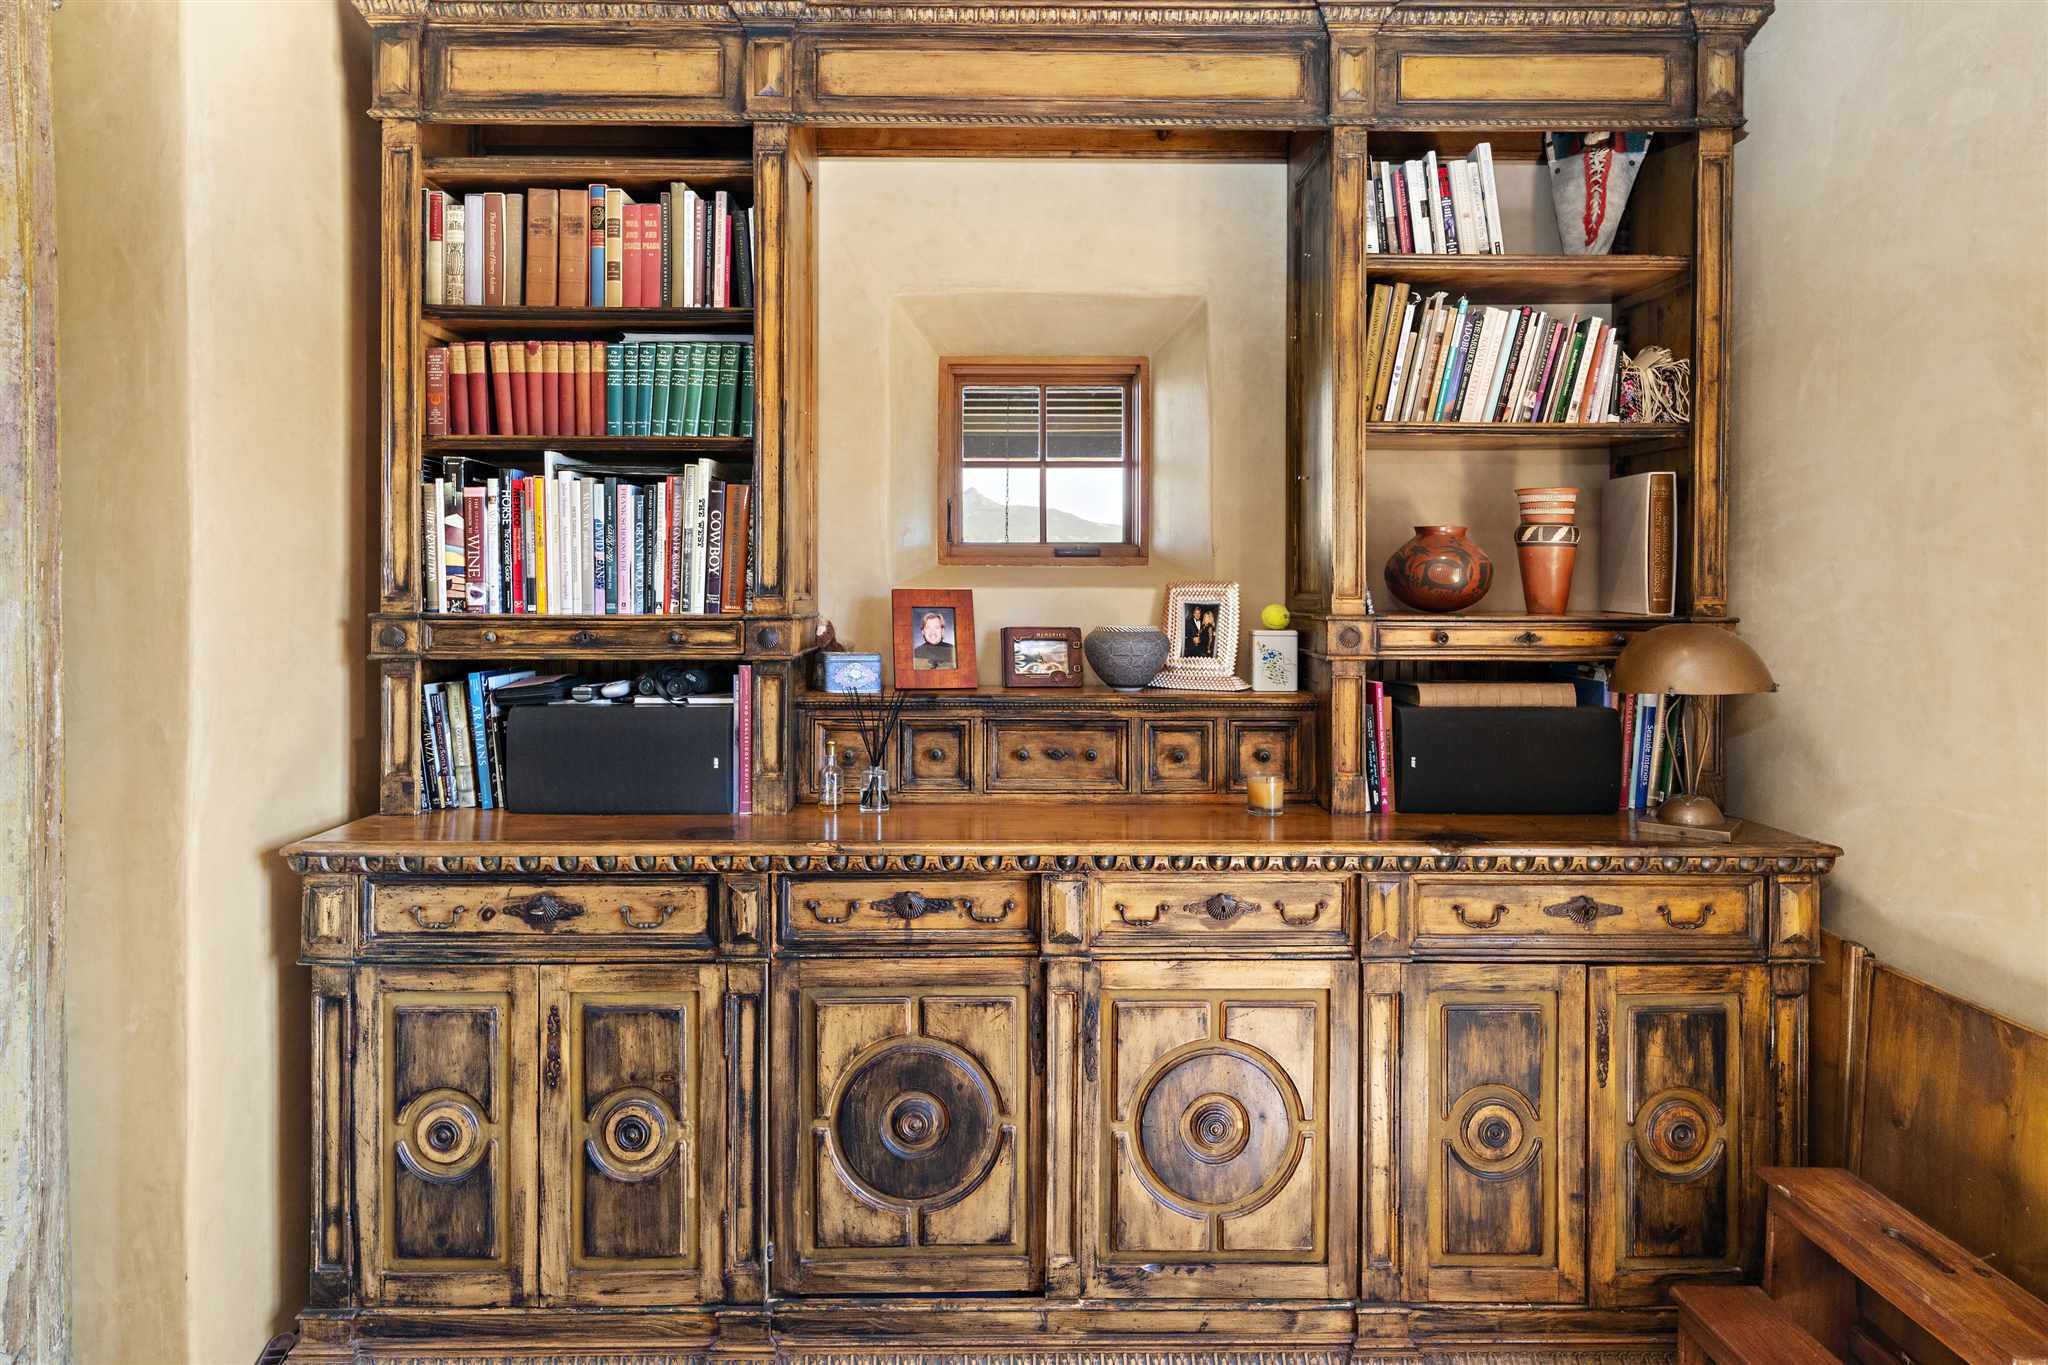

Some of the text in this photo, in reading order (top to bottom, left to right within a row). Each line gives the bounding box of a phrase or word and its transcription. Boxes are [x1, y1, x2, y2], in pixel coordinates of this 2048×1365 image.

[1461, 321, 1472, 353] ADOBE
[1464, 320, 1483, 374] THE FARMHOUSE
[502, 489, 511, 526] HORSE
[636, 522, 644, 557] GRANT
[673, 527, 681, 540] ON
[710, 510, 722, 576] COWBOY
[468, 534, 481, 578] WINE
[472, 704, 486, 767] ARABIANS
[1643, 754, 1652, 786] Interiors
